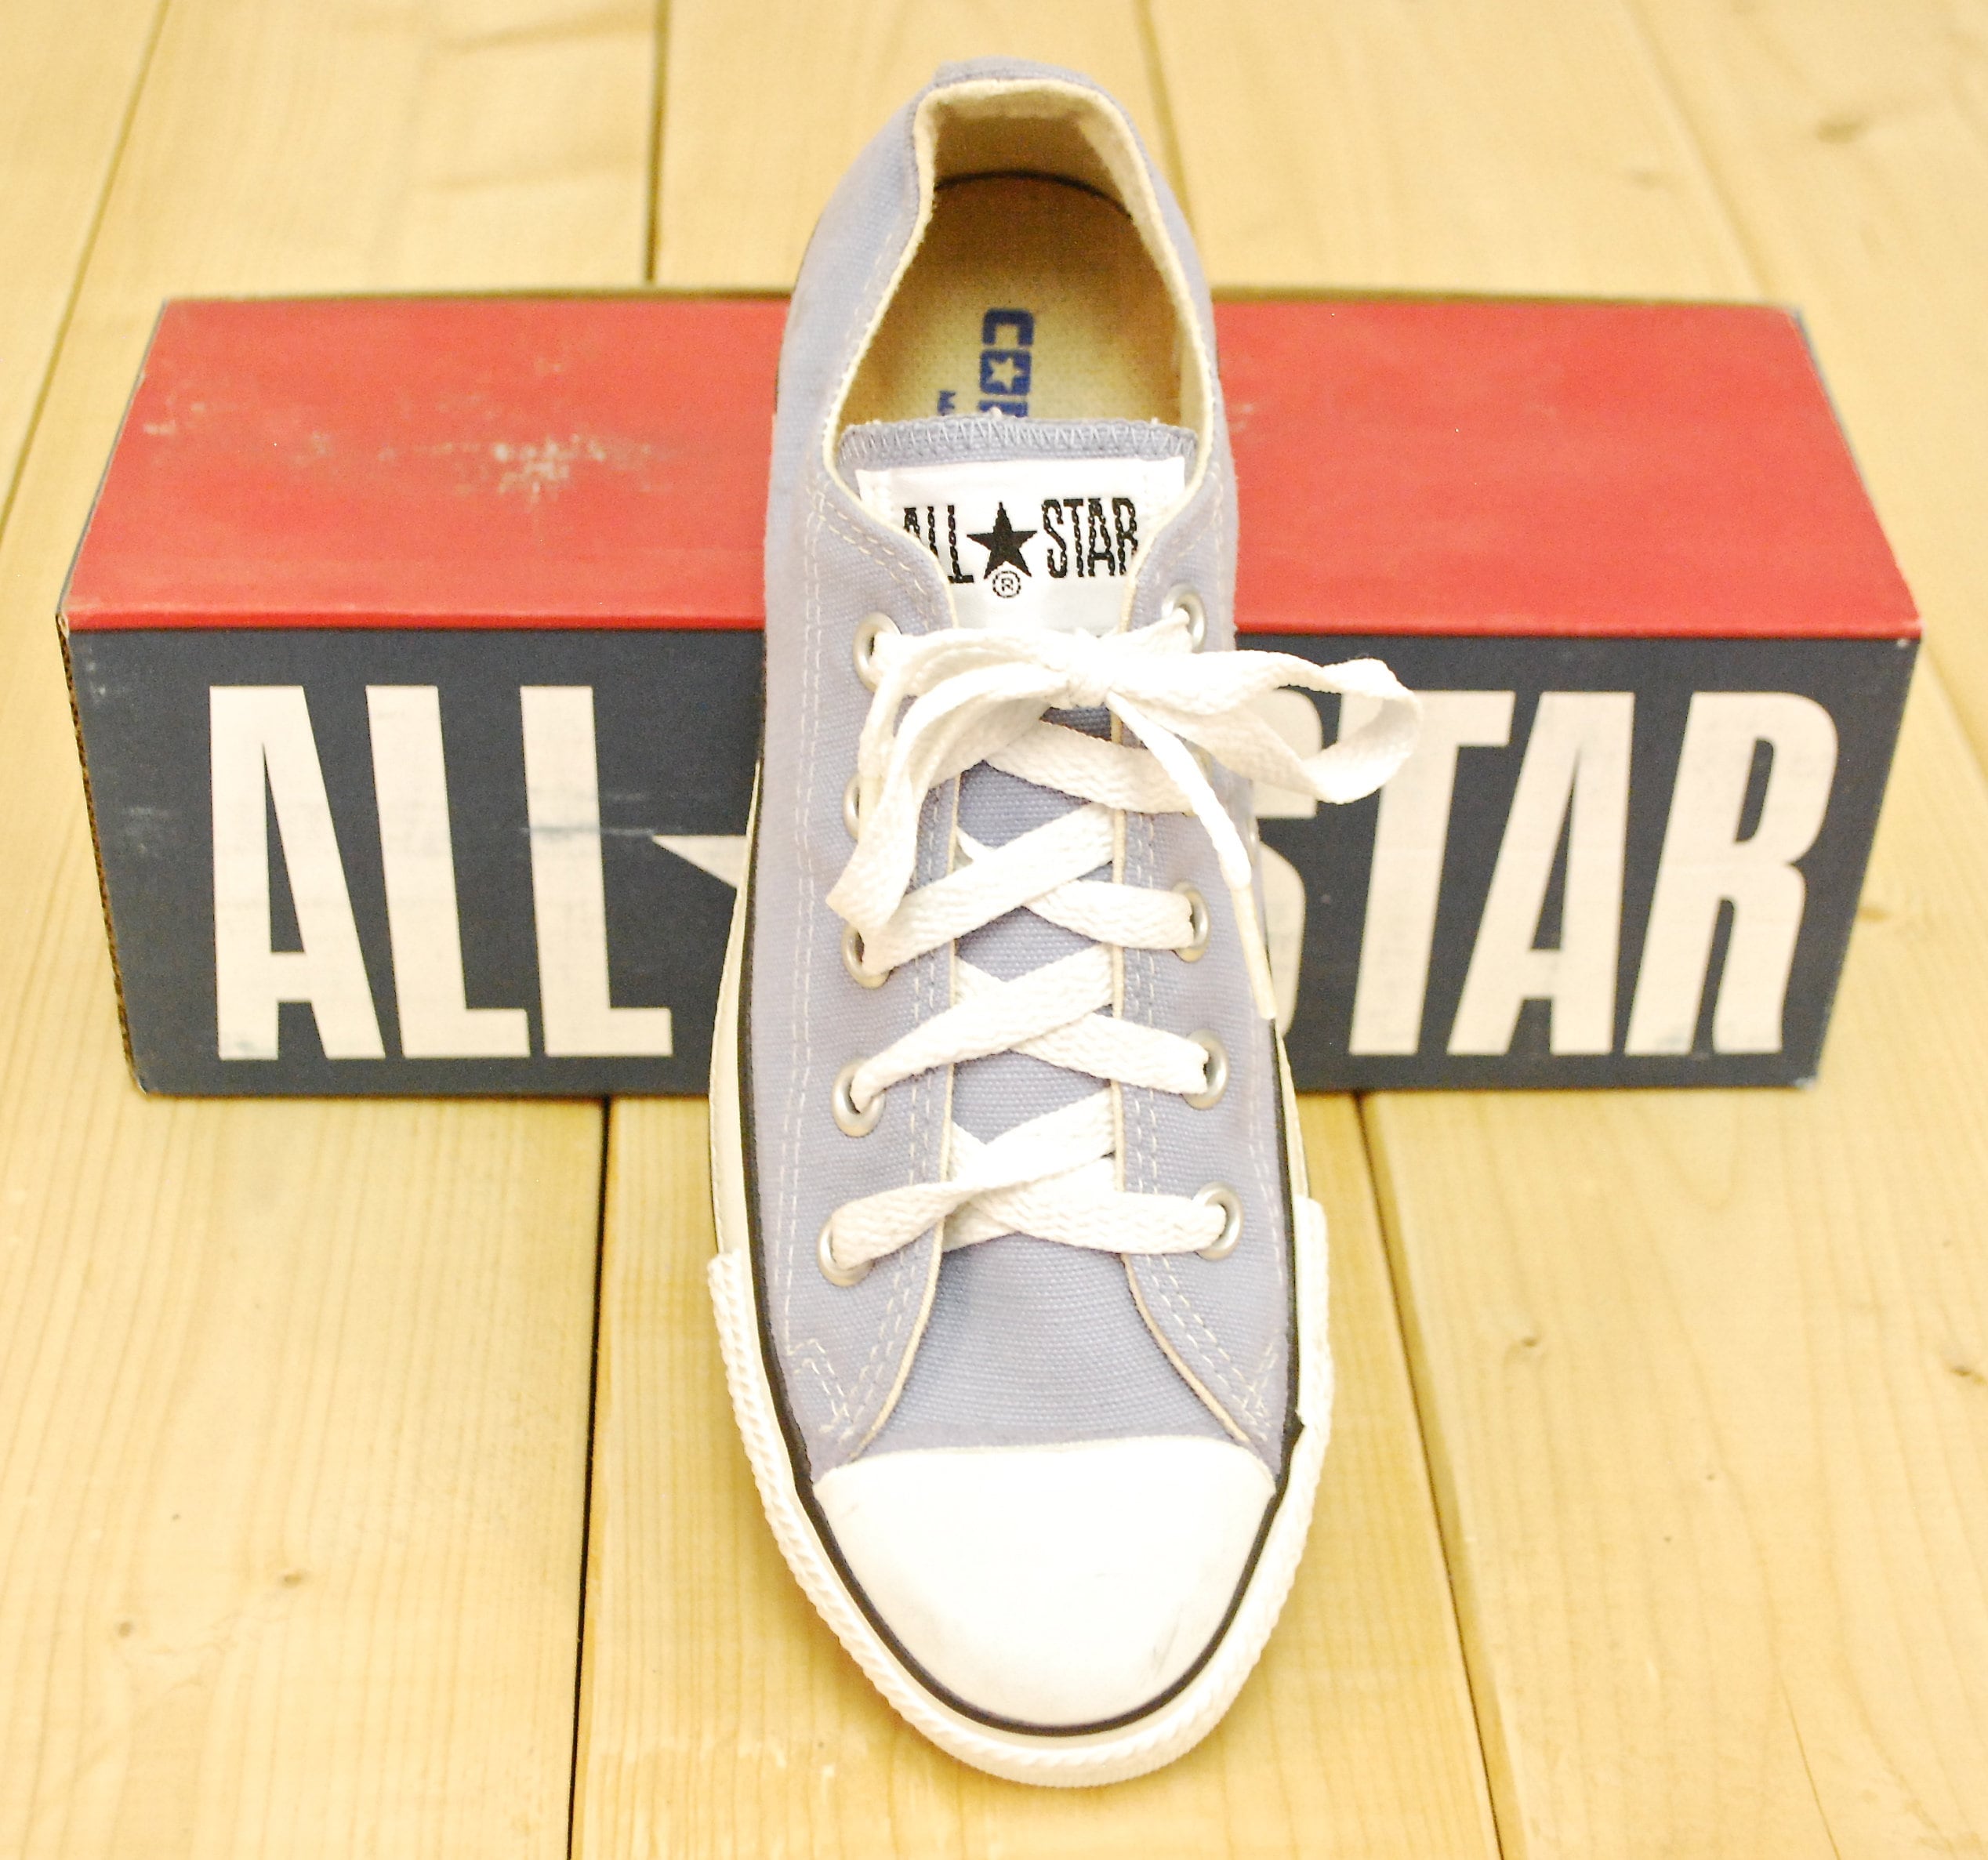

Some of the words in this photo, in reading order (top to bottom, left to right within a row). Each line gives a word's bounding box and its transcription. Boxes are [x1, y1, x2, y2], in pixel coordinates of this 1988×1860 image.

[977, 307, 1035, 417] CO
[1041, 497, 1139, 578] STAR
[209, 685, 673, 1060] ALL
